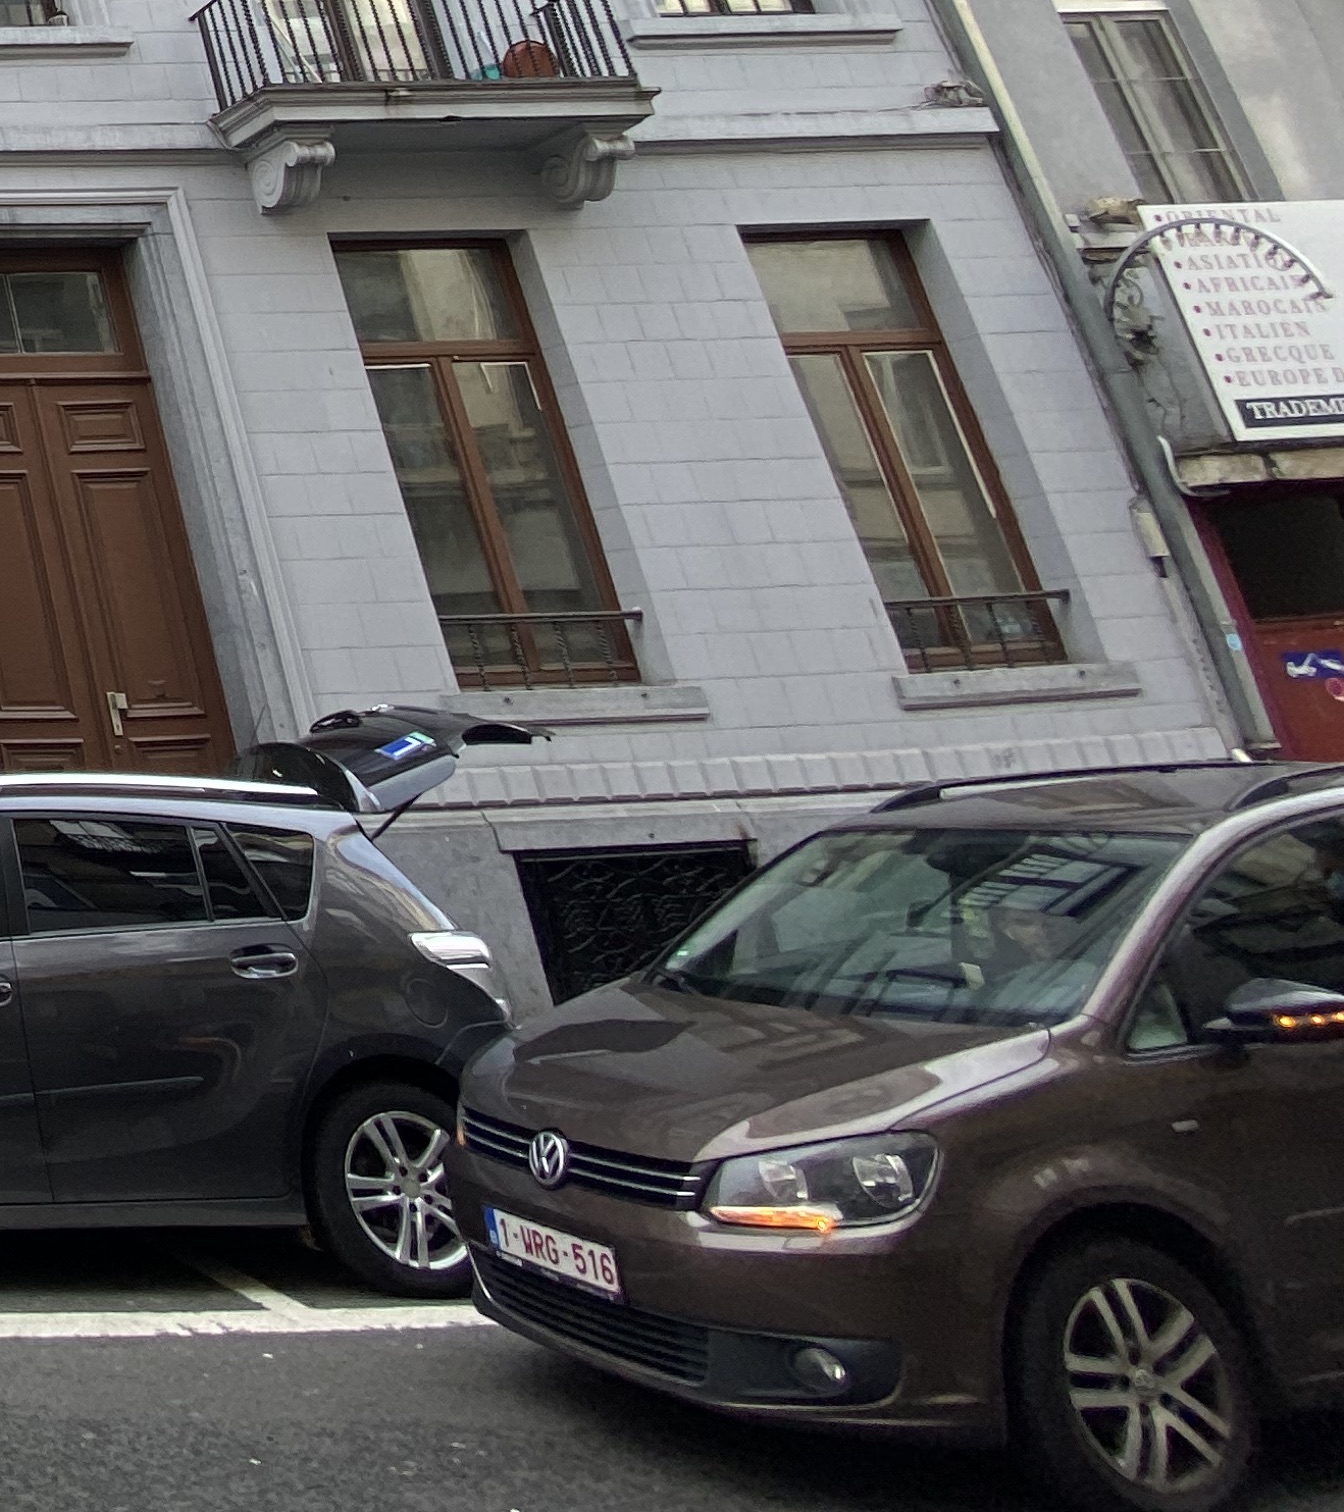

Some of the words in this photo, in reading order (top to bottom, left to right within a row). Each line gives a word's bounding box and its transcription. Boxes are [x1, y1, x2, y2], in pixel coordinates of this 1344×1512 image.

[1215, 322, 1311, 340] ITALIEN
[1226, 344, 1335, 364] GRECQUE
[1235, 368, 1329, 387] EUROPE
